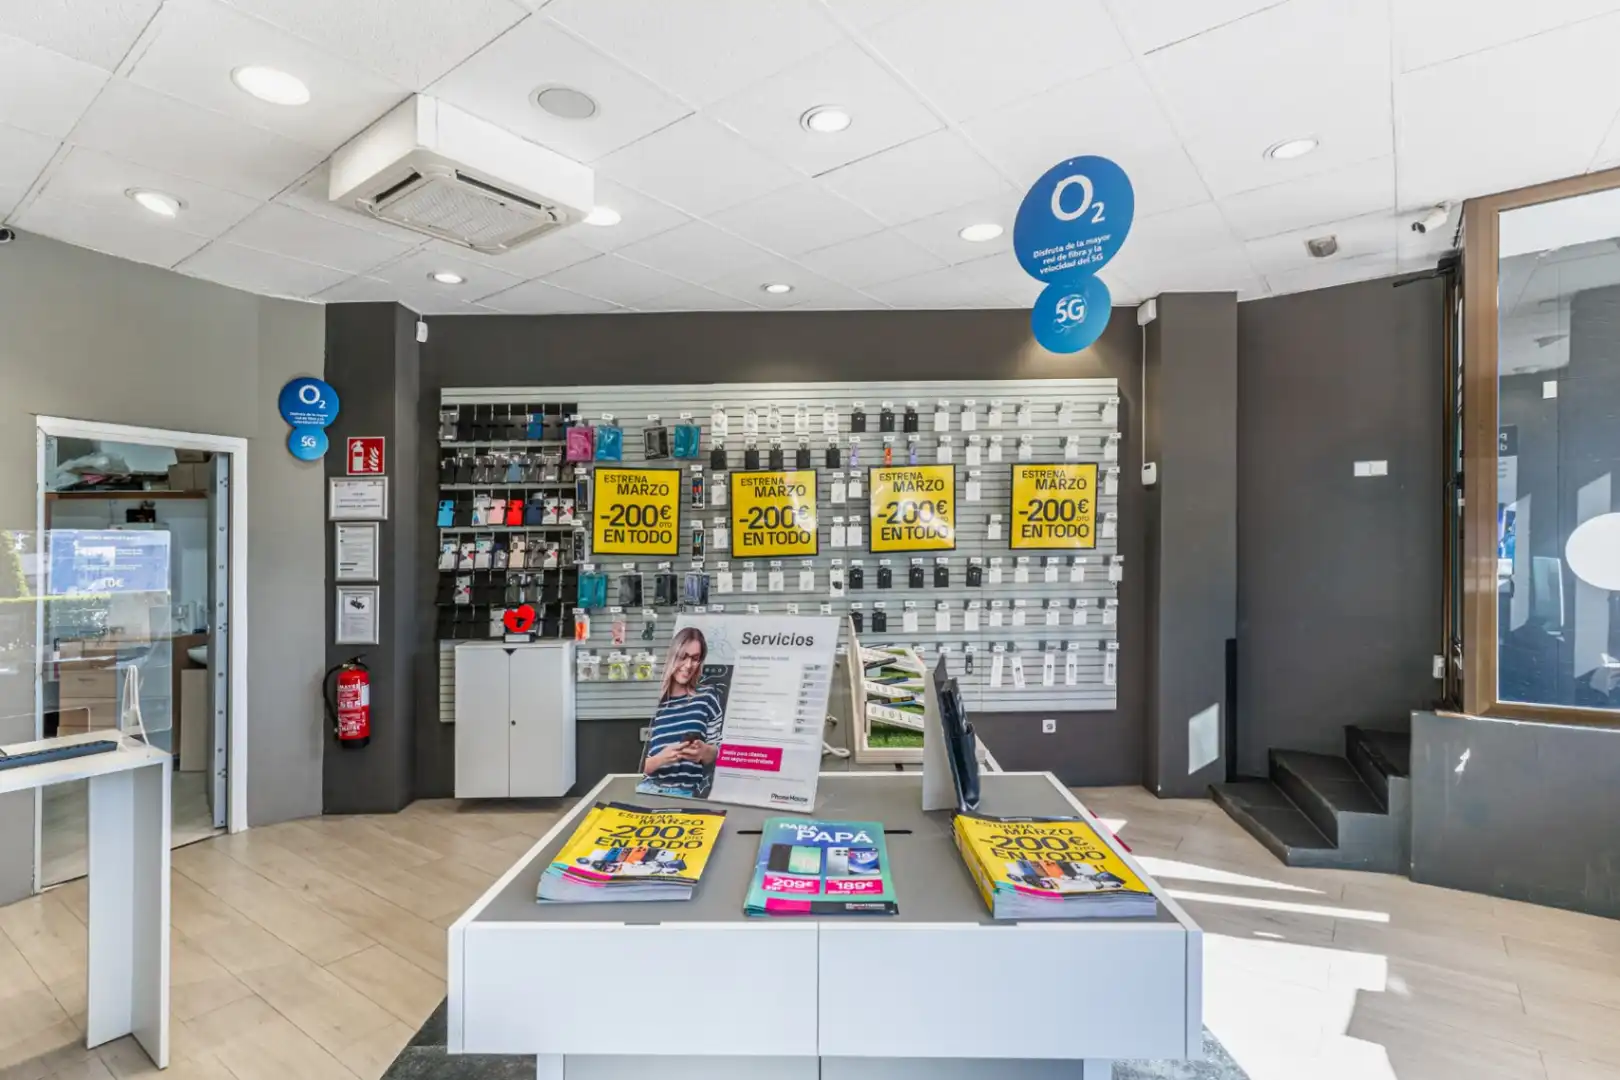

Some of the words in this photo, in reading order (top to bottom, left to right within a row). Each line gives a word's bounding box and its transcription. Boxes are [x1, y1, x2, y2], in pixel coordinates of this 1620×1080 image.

[1033, 246, 1064, 258] Disfruta
[1065, 242, 1075, 250] de
[1076, 240, 1085, 248] la
[1086, 234, 1112, 246] mayor
[1043, 256, 1057, 265] red
[1057, 253, 1067, 262] de
[1068, 249, 1087, 259] fibra
[1094, 245, 1102, 253] la
[1040, 261, 1077, 275] velocidad
[1078, 257, 1090, 265] del
[1091, 253, 1104, 262] 5G
[1055, 299, 1085, 323] 5G
[301, 436, 316, 447] 5G
[604, 474, 648, 484] ESTRENA
[879, 472, 923, 482] ESTRENA
[1022, 470, 1066, 479] ESTRENA
[741, 477, 784, 487] ESTRENA
[893, 479, 945, 493] MARZO
[1036, 479, 1087, 490] MARZO
[617, 484, 669, 496] MARZO
[754, 485, 806, 498] MARZO
[604, 529, 625, 543] EN
[630, 530, 672, 544] TODO
[881, 527, 903, 541] EN
[907, 525, 949, 540] TODO
[1022, 524, 1042, 538] EN
[1046, 524, 1089, 538] TODO
[743, 531, 764, 546] EN
[769, 531, 811, 545] TODO
[741, 632, 814, 647] Servicios
[618, 812, 673, 820] ESTRENA
[639, 818, 704, 826] MARZO
[779, 823, 819, 832] PARA
[595, 837, 628, 848] EN
[634, 839, 703, 849] TODO
[796, 830, 873, 844] PAPÁ
[990, 847, 1028, 860] EN
[1028, 851, 1106, 861] TODO
